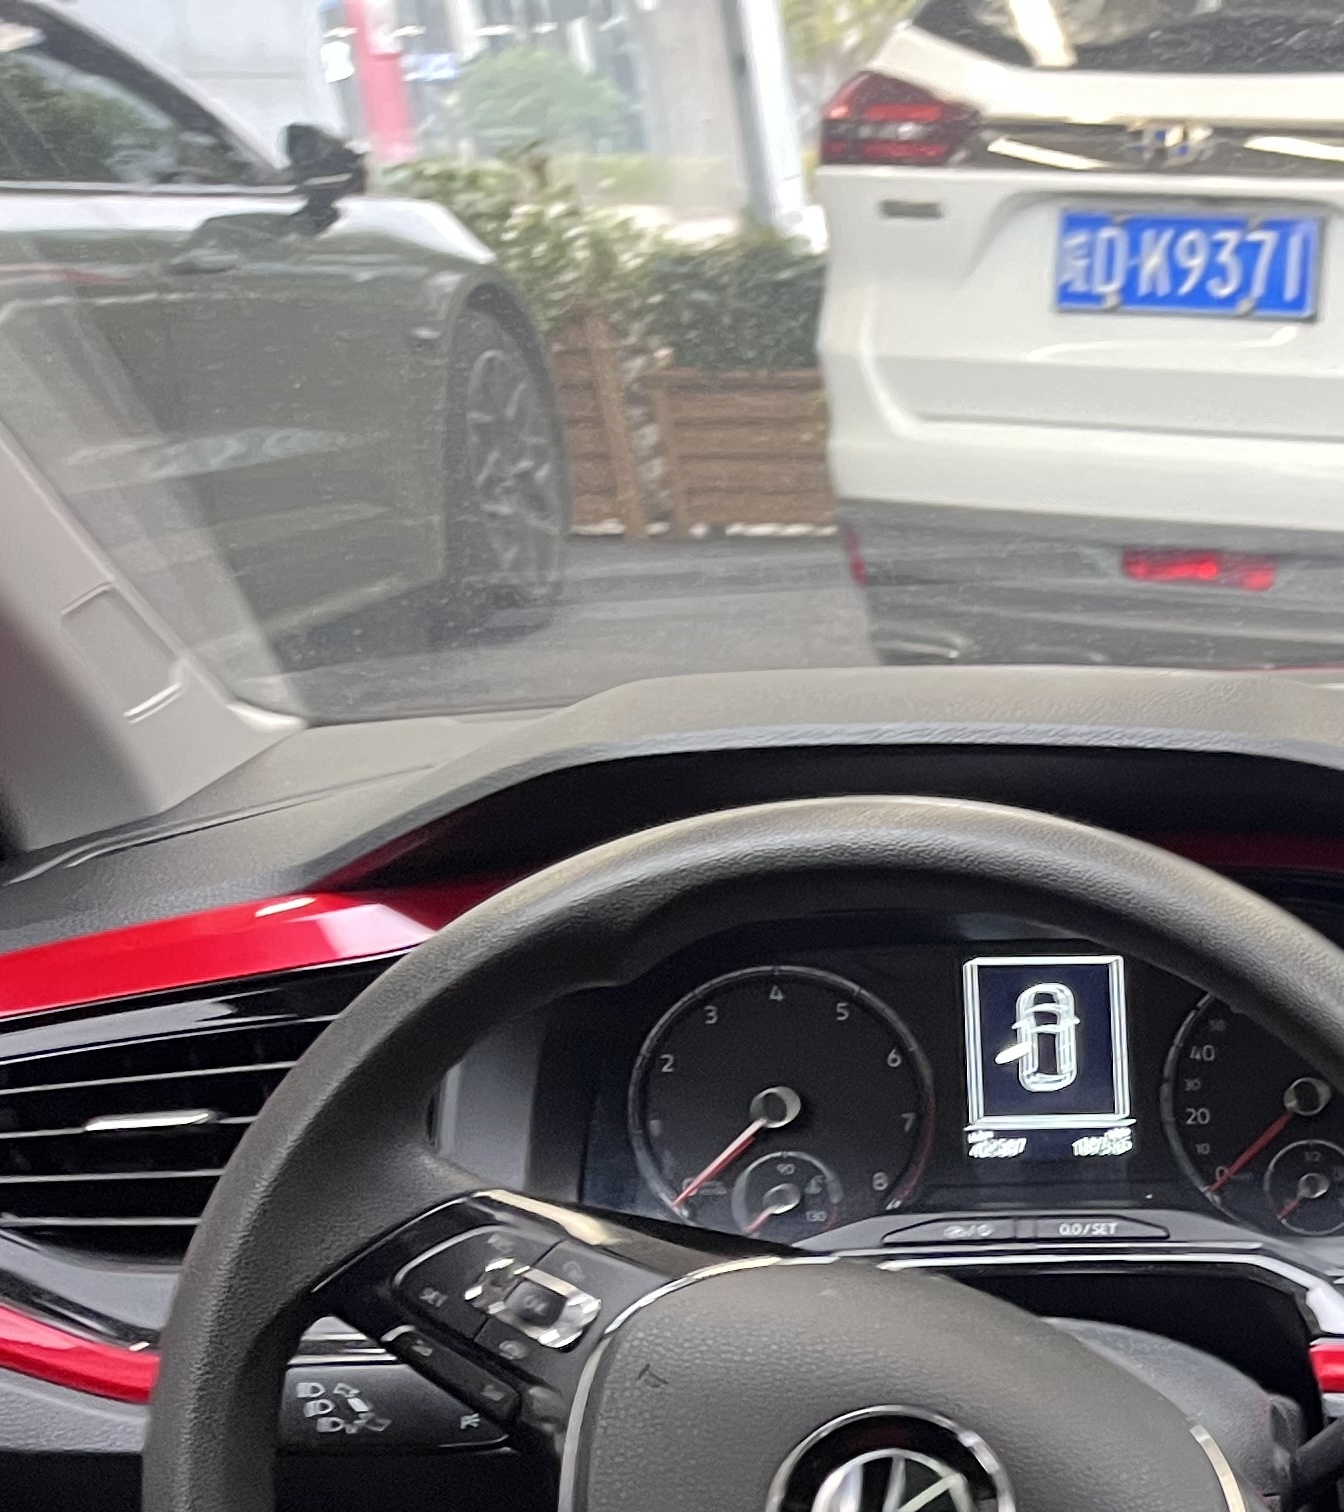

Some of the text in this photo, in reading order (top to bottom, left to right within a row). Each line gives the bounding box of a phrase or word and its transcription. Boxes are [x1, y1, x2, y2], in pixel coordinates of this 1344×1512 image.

[768, 985, 784, 1001] 4
[704, 1005, 718, 1024] 3
[836, 1003, 849, 1021] 5
[887, 1047, 901, 1068] 6
[1189, 1045, 1215, 1061] 40
[660, 1054, 675, 1073] 2
[901, 1113, 916, 1132] 7
[1186, 1108, 1210, 1125] 20
[872, 1171, 888, 1191] 8
